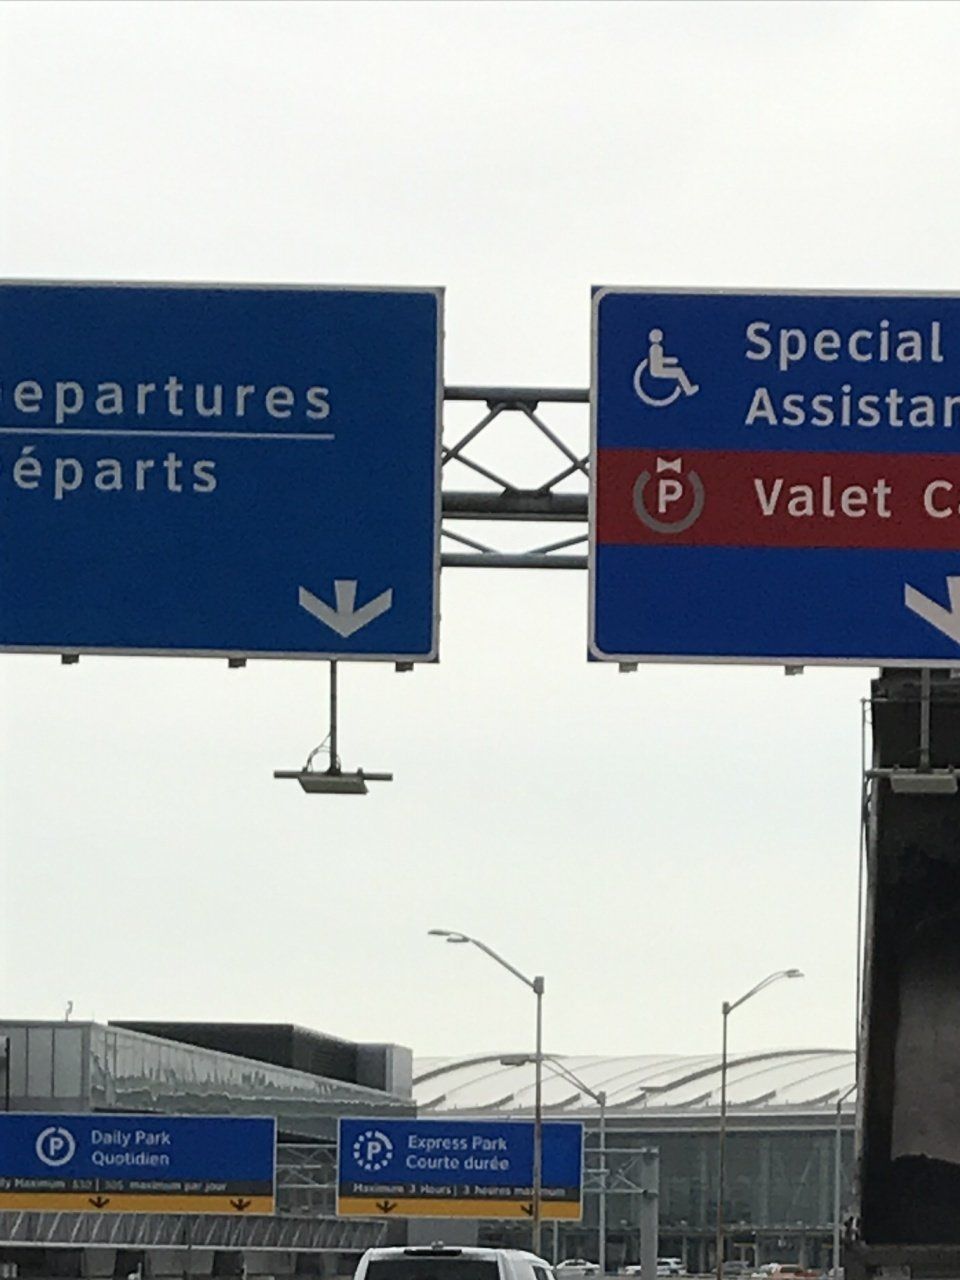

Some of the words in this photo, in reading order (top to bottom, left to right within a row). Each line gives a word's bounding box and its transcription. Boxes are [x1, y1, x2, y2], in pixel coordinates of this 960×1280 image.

[745, 319, 944, 371] Special
[0, 376, 331, 424] epartures
[0, 446, 218, 500] éparts
[754, 476, 891, 518] Valet
[91, 1129, 131, 1148] Daily
[135, 1130, 171, 1145] Park
[408, 1135, 467, 1152] Express
[472, 1136, 507, 1150] Park
[91, 1151, 170, 1167] Quotidien
[406, 1154, 460, 1169] Courte
[464, 1155, 509, 1170] durée
